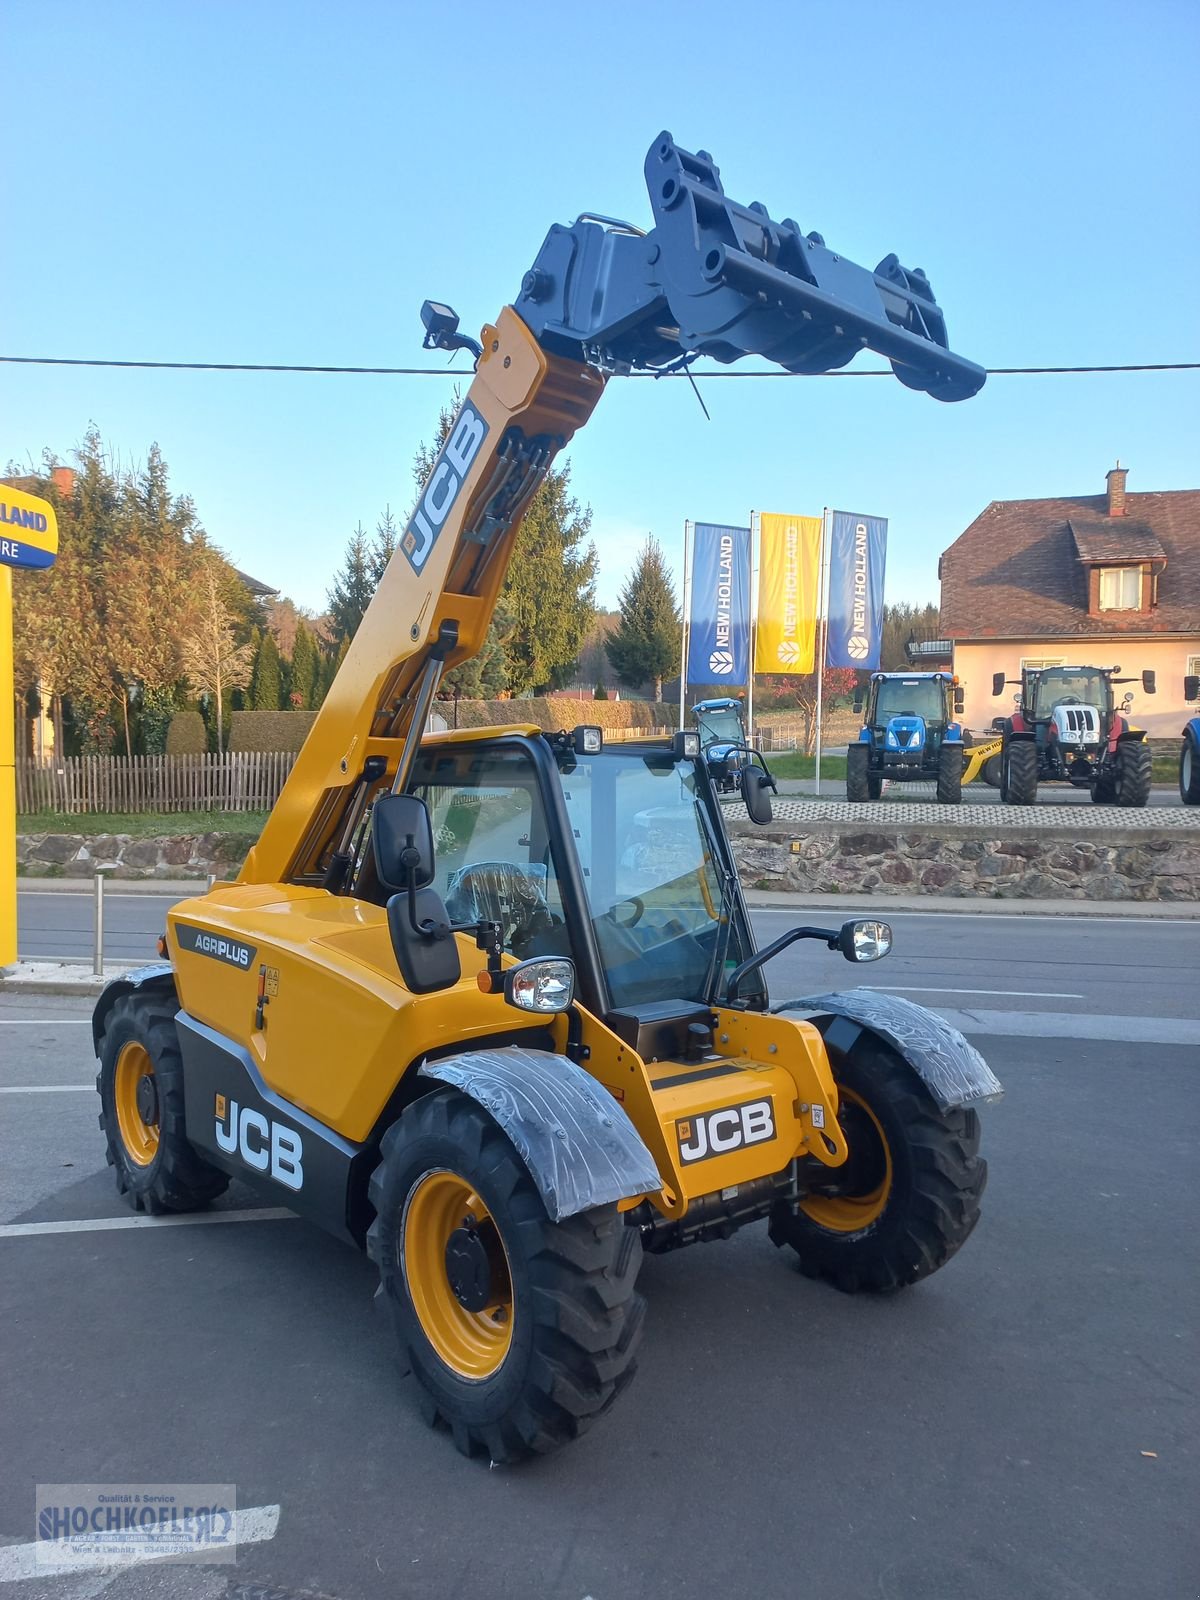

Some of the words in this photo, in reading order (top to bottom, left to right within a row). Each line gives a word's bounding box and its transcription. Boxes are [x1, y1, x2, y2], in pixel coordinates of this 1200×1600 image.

[0, 503, 47, 532] LAND
[411, 408, 484, 567] JCB
[718, 535, 733, 609] HOLLAND
[785, 526, 798, 601] HOLLAND
[855, 523, 867, 596] HOLLAND
[716, 612, 730, 647] NEW
[784, 602, 797, 637] NEW
[854, 597, 865, 633] NEW
[215, 1100, 303, 1191] JCB
[681, 1101, 774, 1161] JCB
